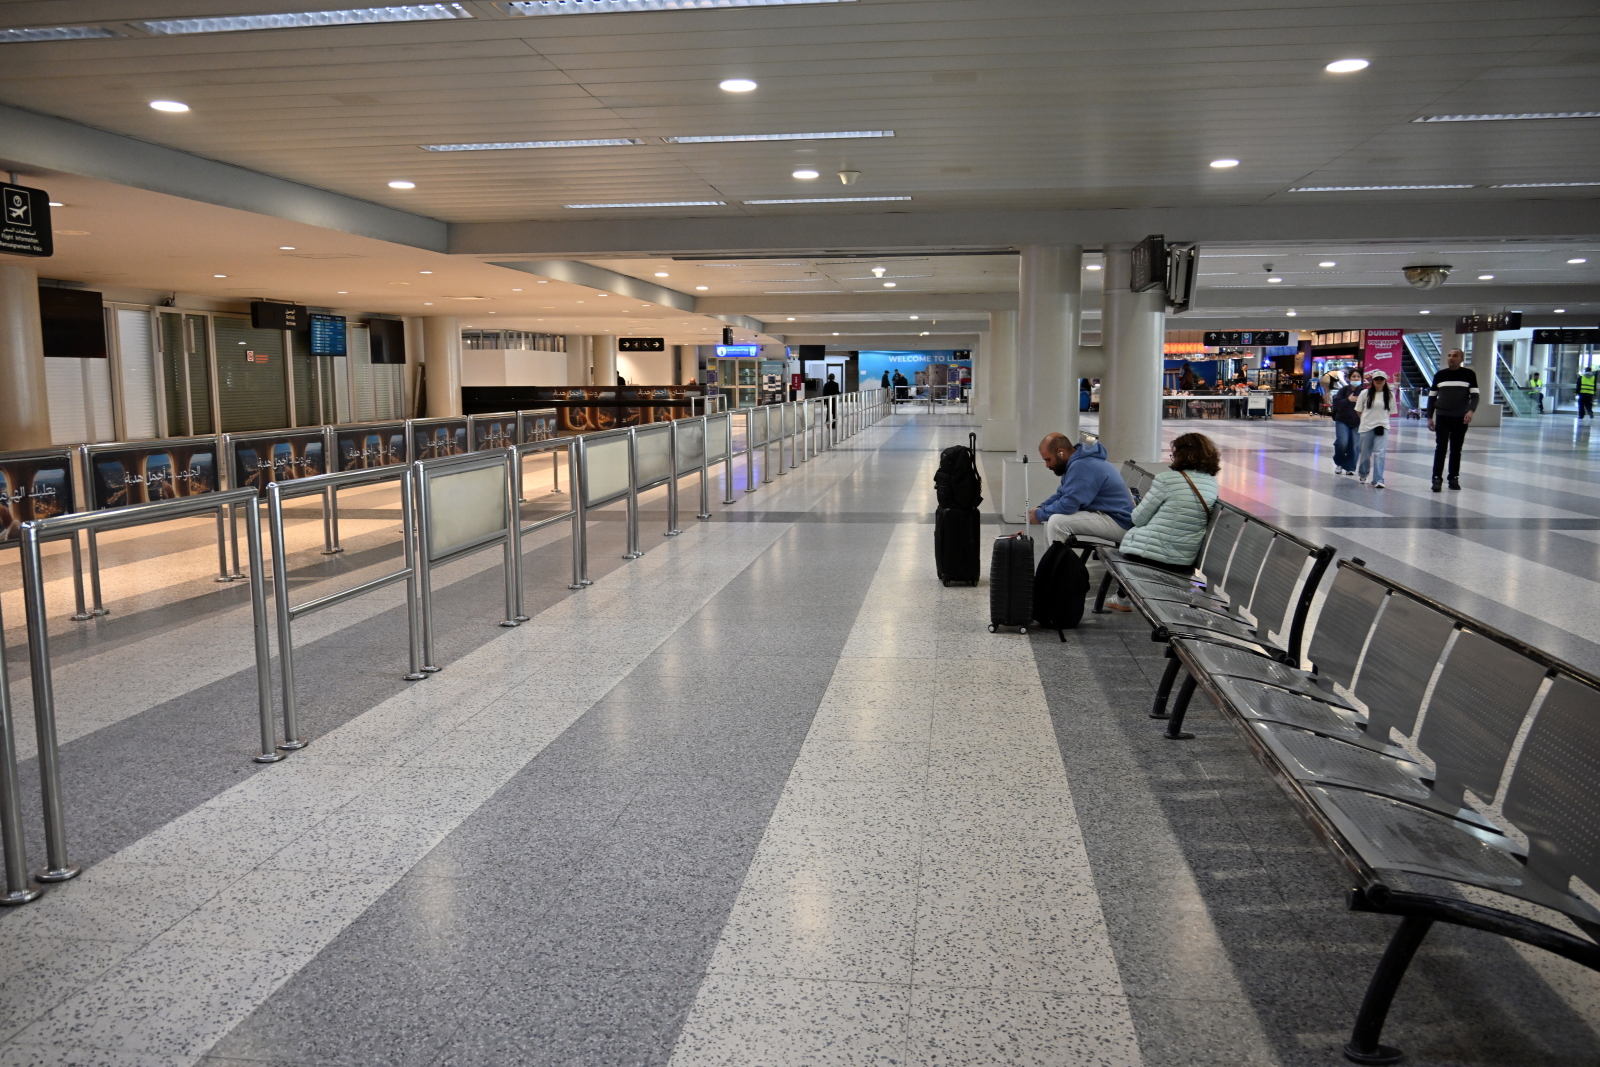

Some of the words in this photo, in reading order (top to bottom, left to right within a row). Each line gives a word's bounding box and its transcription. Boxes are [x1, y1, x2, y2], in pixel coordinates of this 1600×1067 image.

[1, 233, 14, 241] Flight
[15, 234, 39, 243] Information
[888, 355, 931, 363] WELCOME
[124, 471, 144, 486] هدية
[145, 465, 166, 486] أجمل
[175, 465, 201, 482] الجنوب
[0, 485, 26, 505] الهرم
[28, 483, 57, 498] بعلبك
